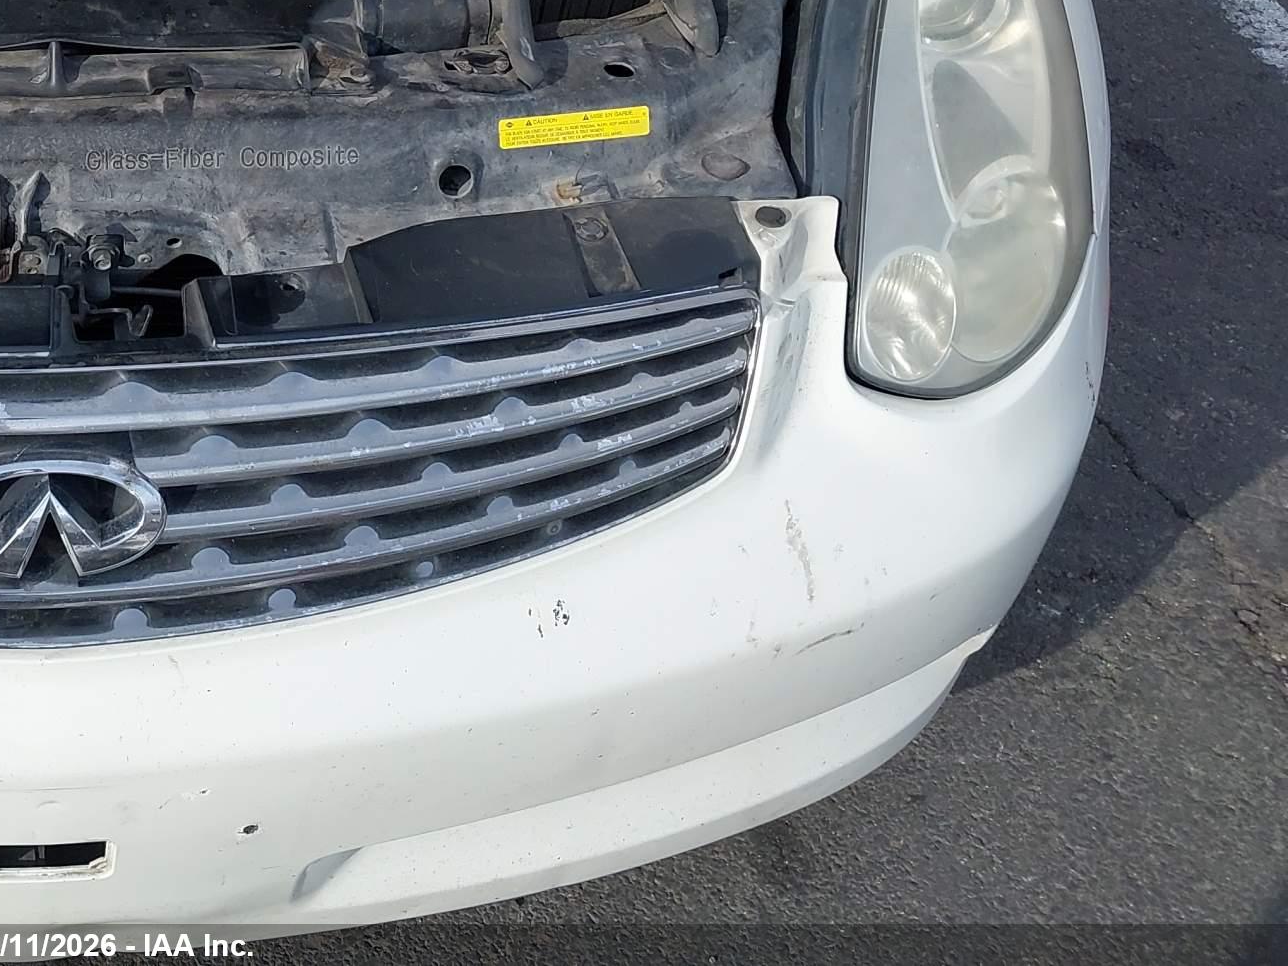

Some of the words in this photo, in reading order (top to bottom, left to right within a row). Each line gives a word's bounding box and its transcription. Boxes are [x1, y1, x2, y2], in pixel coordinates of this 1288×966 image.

[532, 117, 557, 125] CAUTION
[85, 148, 225, 171] Glass-Fiber
[239, 145, 360, 171] Composite
